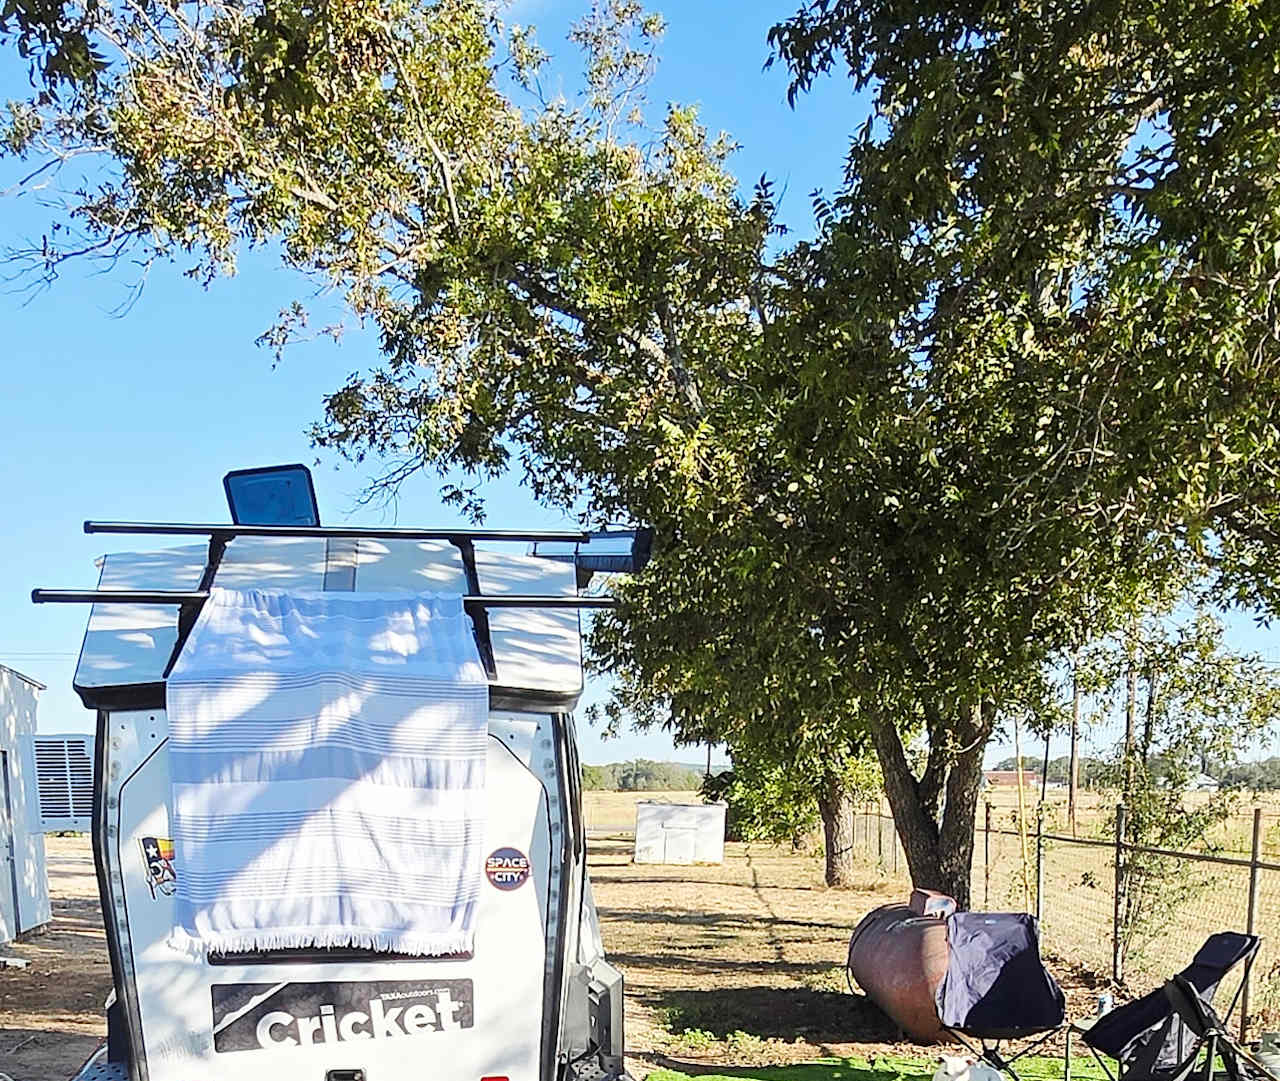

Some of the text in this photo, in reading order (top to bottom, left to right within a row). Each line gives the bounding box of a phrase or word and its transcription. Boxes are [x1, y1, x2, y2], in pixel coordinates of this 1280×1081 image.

[487, 857, 528, 868] SPACE
[494, 871, 521, 883] CITY
[256, 987, 463, 1051] Cricket
